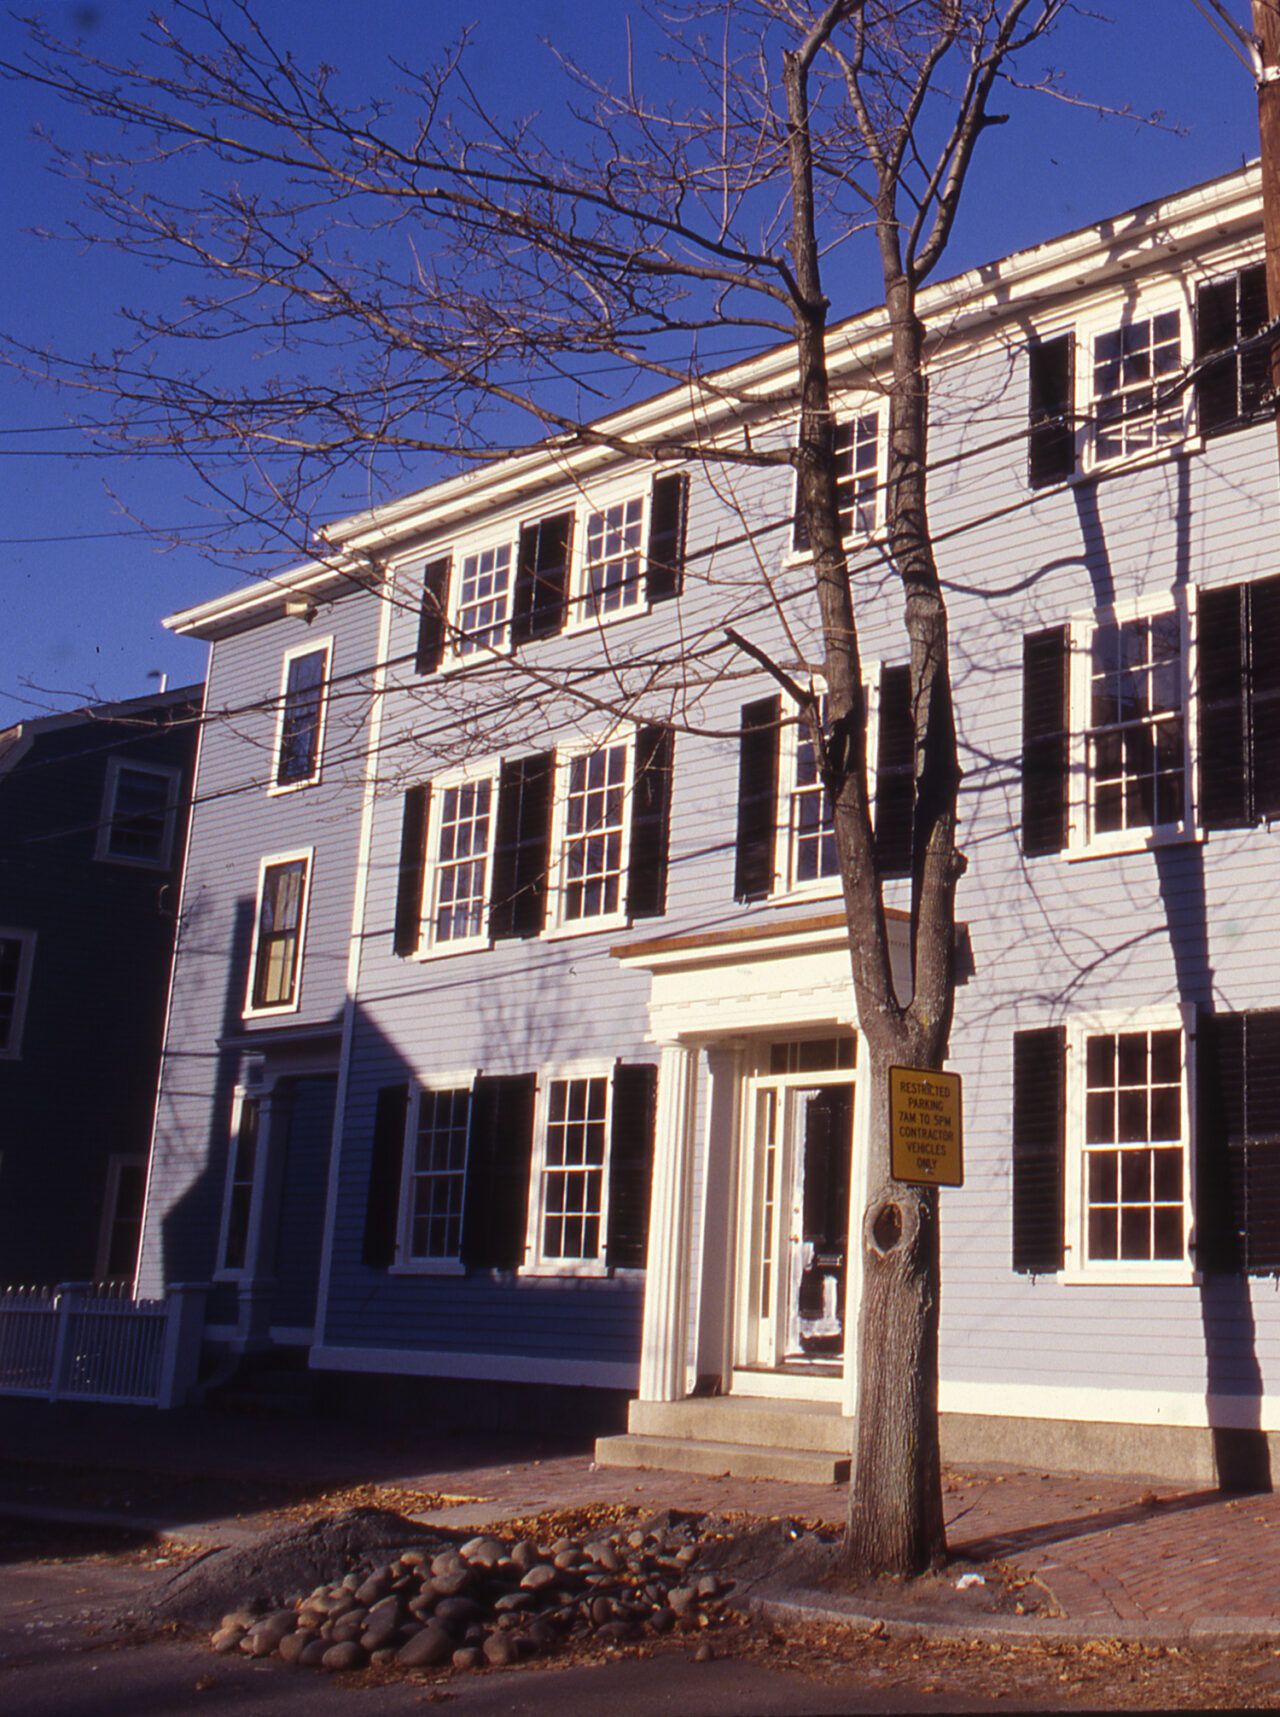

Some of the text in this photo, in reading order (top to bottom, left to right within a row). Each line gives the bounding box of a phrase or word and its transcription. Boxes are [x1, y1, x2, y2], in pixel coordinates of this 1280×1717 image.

[900, 1082, 950, 1098] RESTRICTED
[908, 1098, 943, 1112] PARKING
[899, 1111, 951, 1126] 7AM TO 5PM
[899, 1126, 954, 1140] CONTRACTOR
[905, 1142, 946, 1156] VEHICLES
[917, 1158, 936, 1170] ONLY
